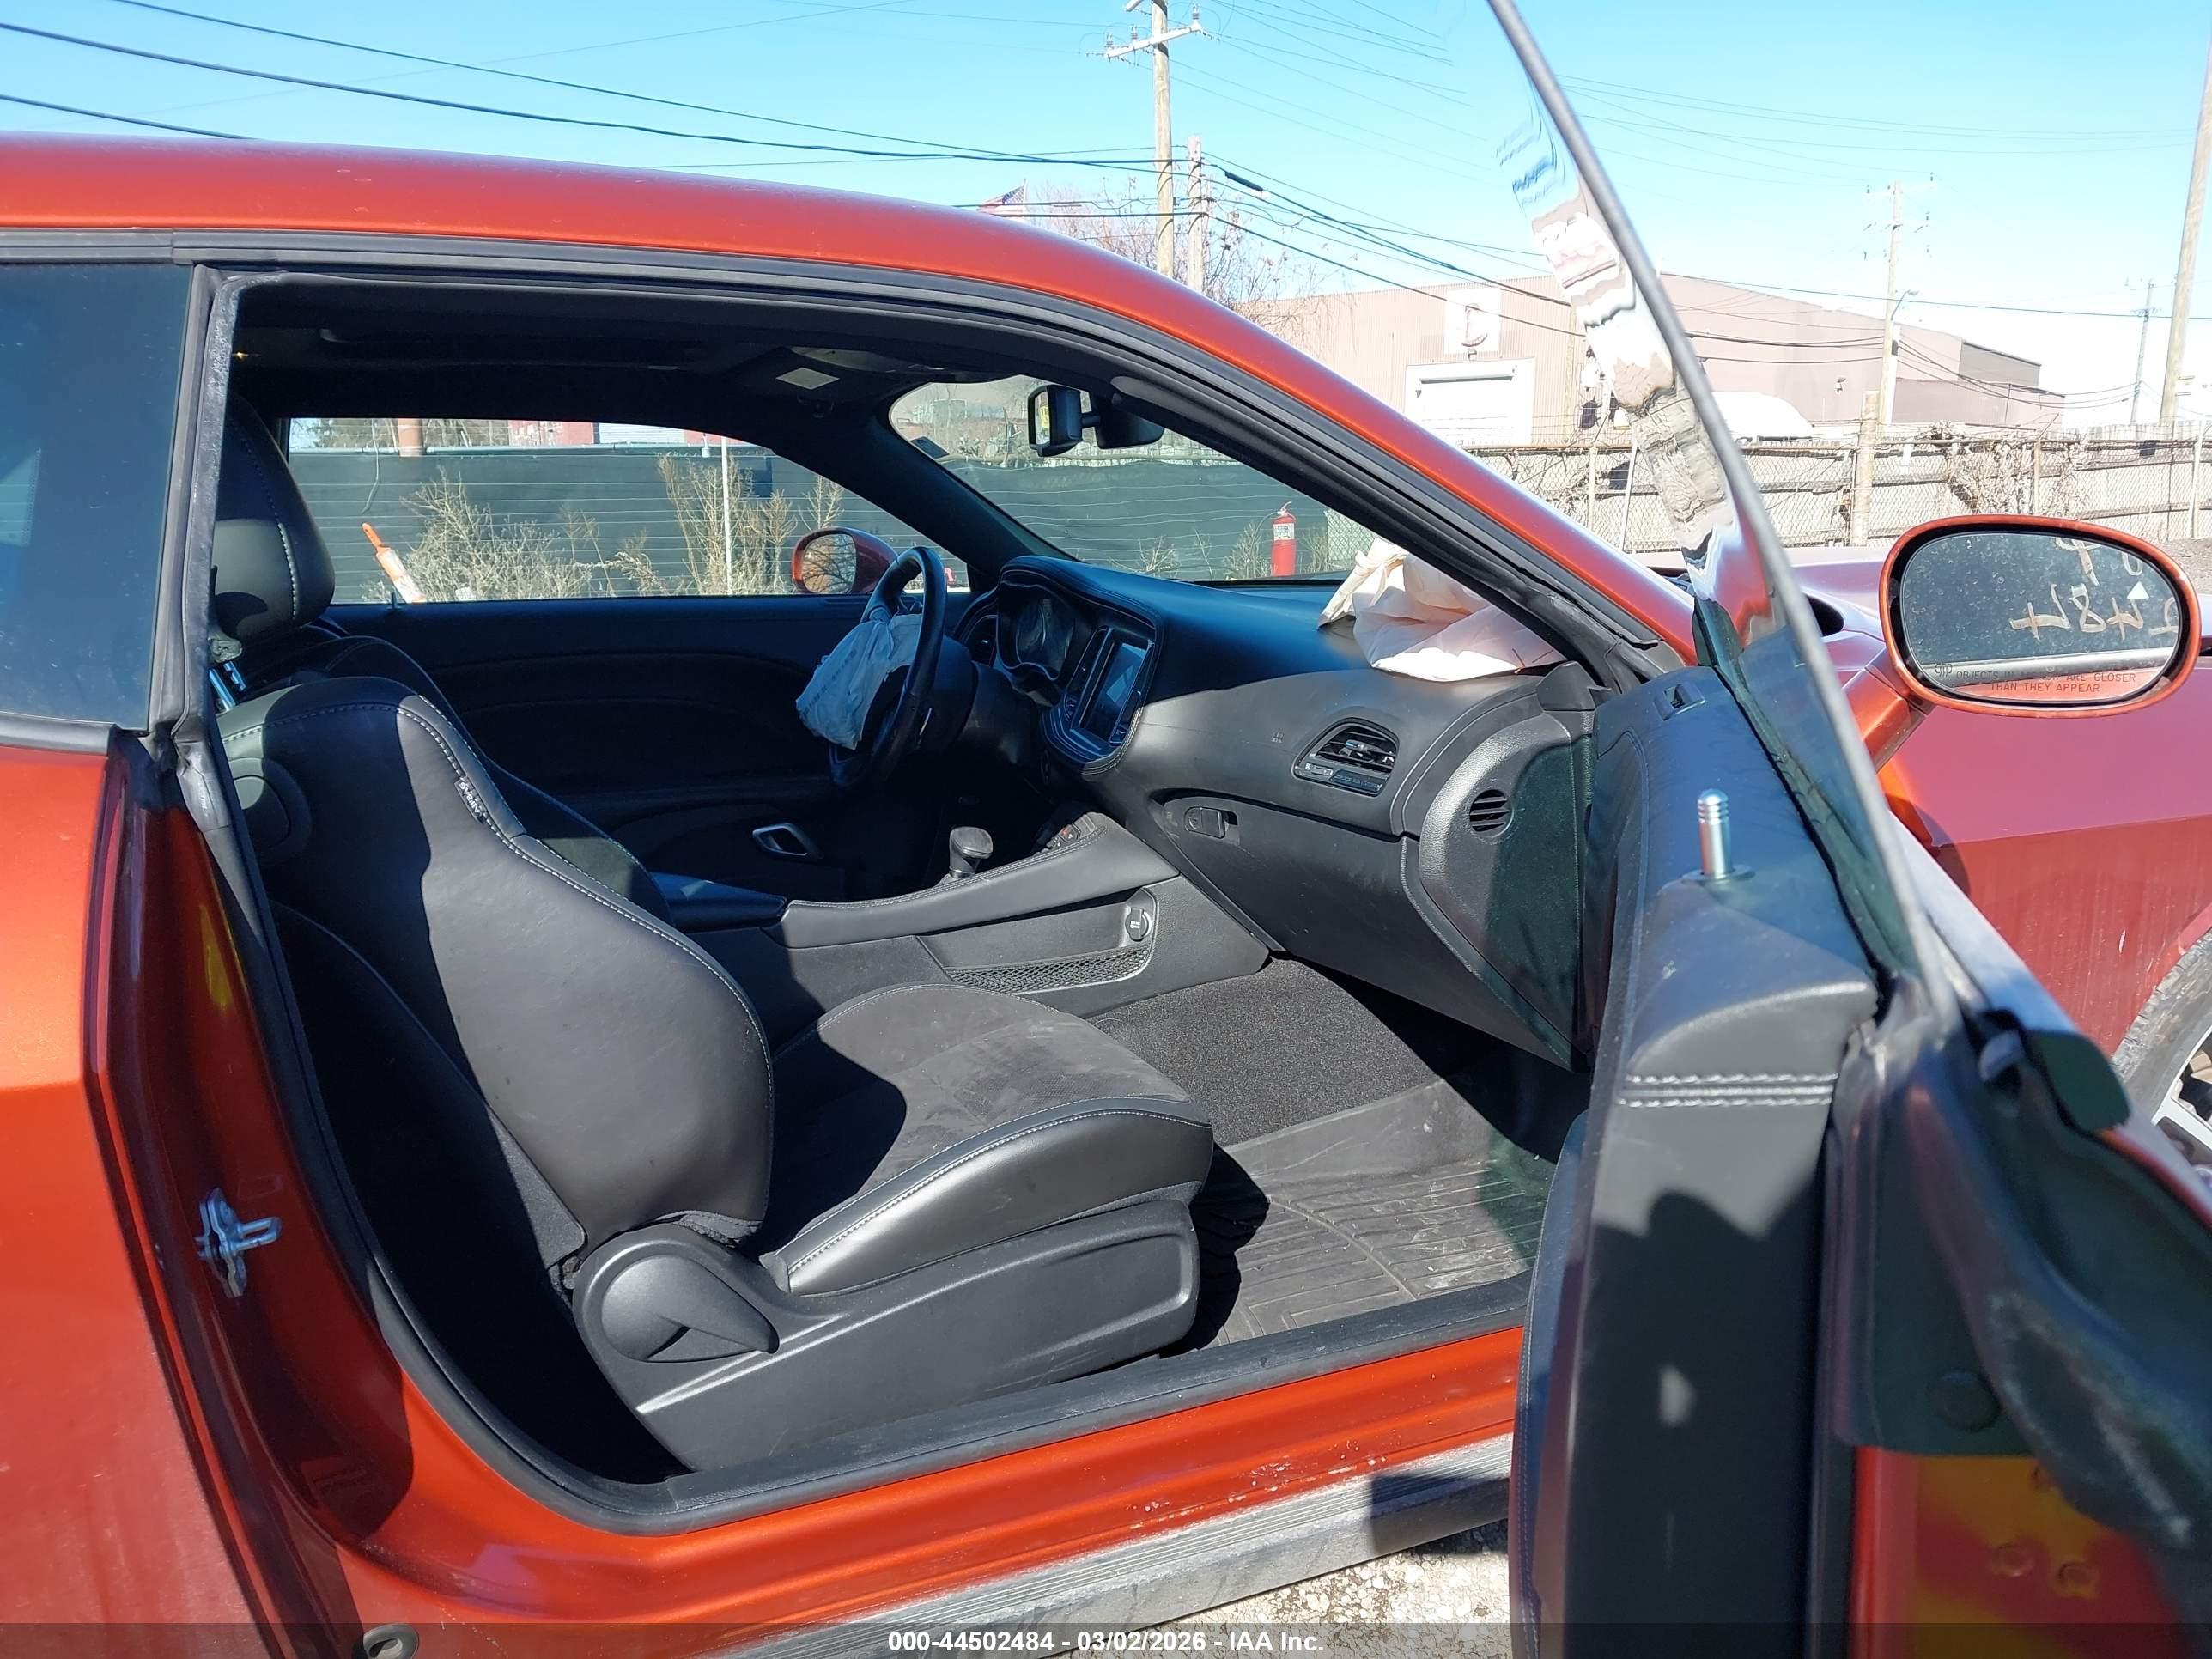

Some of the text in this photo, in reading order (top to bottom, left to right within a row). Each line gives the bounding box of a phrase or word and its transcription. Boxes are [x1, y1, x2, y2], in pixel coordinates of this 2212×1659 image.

[1956, 671, 1999, 680] OBJECTS
[2094, 672, 2136, 682] CLOSER
[1991, 682, 2100, 692] THAN THEY APPEAR
[459, 781, 481, 813] AIRBAG
